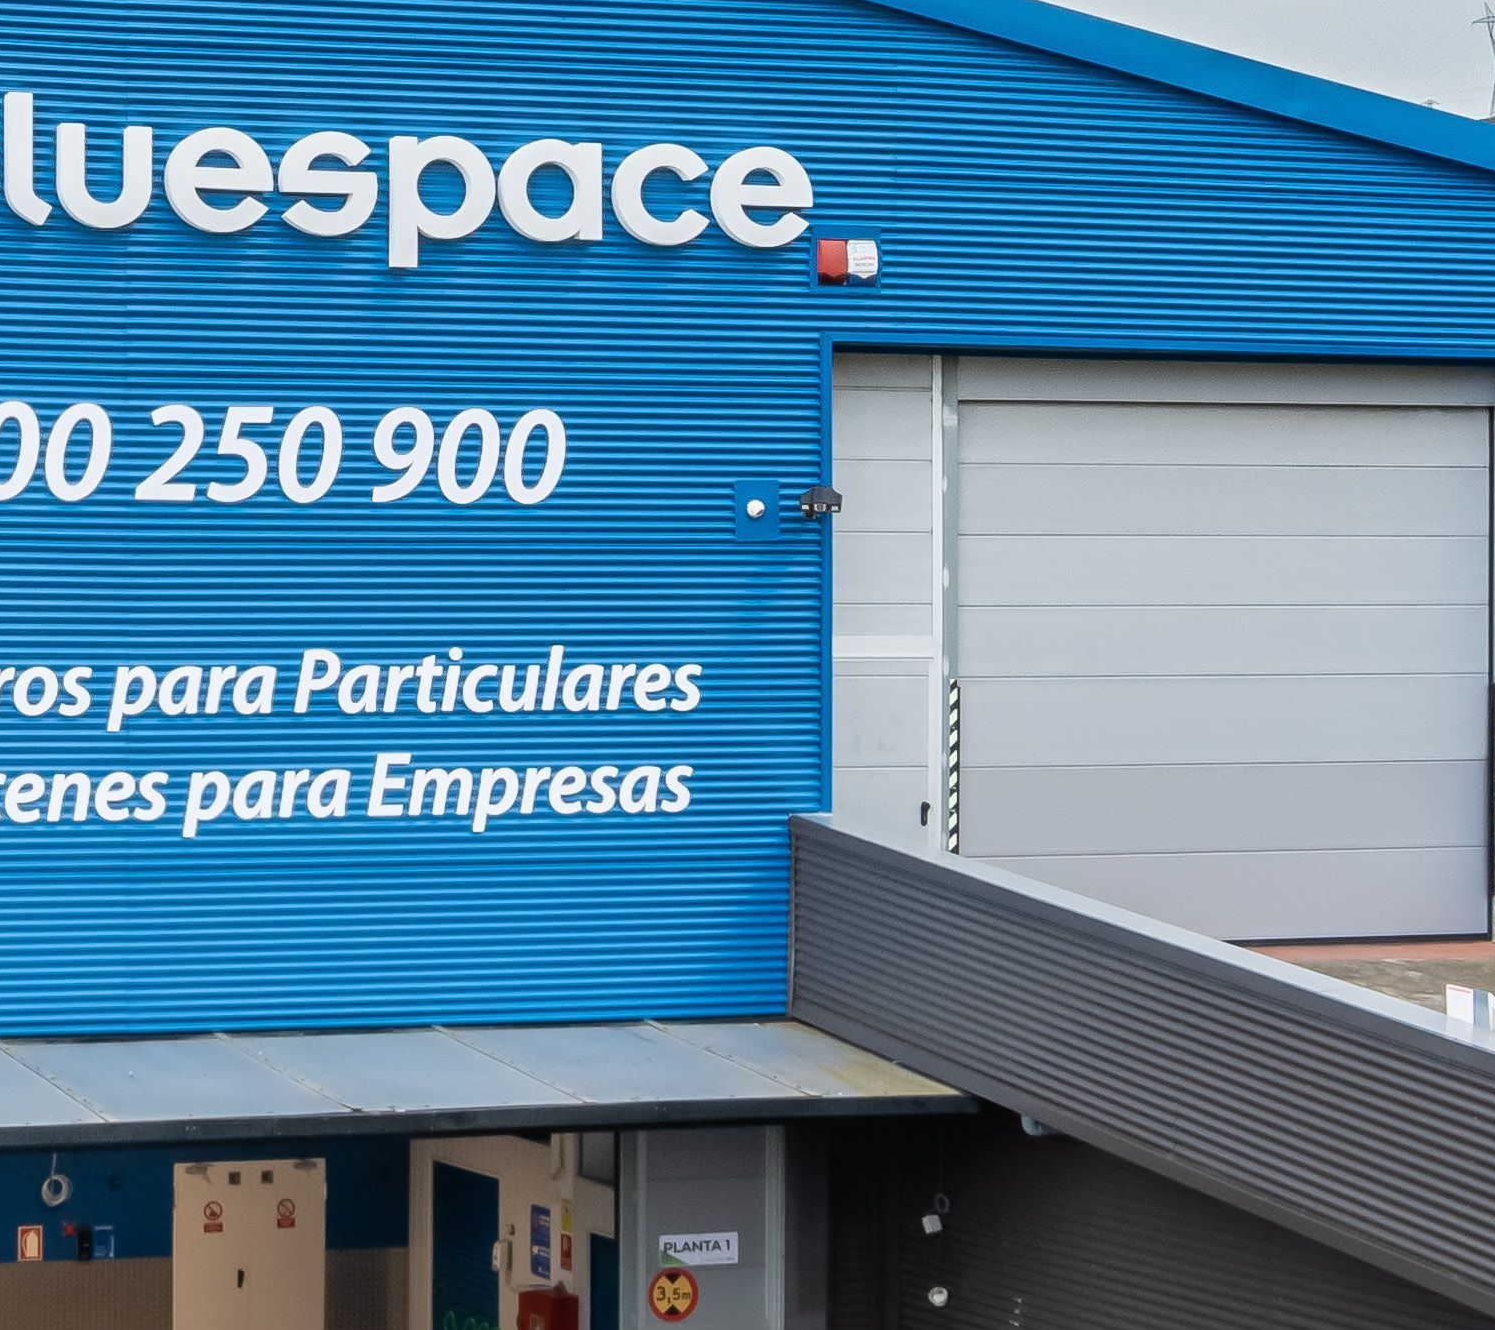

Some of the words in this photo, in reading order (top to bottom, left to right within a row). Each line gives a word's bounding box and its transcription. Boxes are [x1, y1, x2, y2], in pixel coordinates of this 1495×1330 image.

[134, 404, 343, 504] 250
[370, 407, 567, 505] 900
[107, 665, 277, 732] para
[294, 644, 702, 716] Particulares
[182, 770, 351, 838] para
[367, 752, 693, 833] Empresas
[663, 1240, 721, 1253] PLANTA
[726, 1239, 731, 1251] 1
